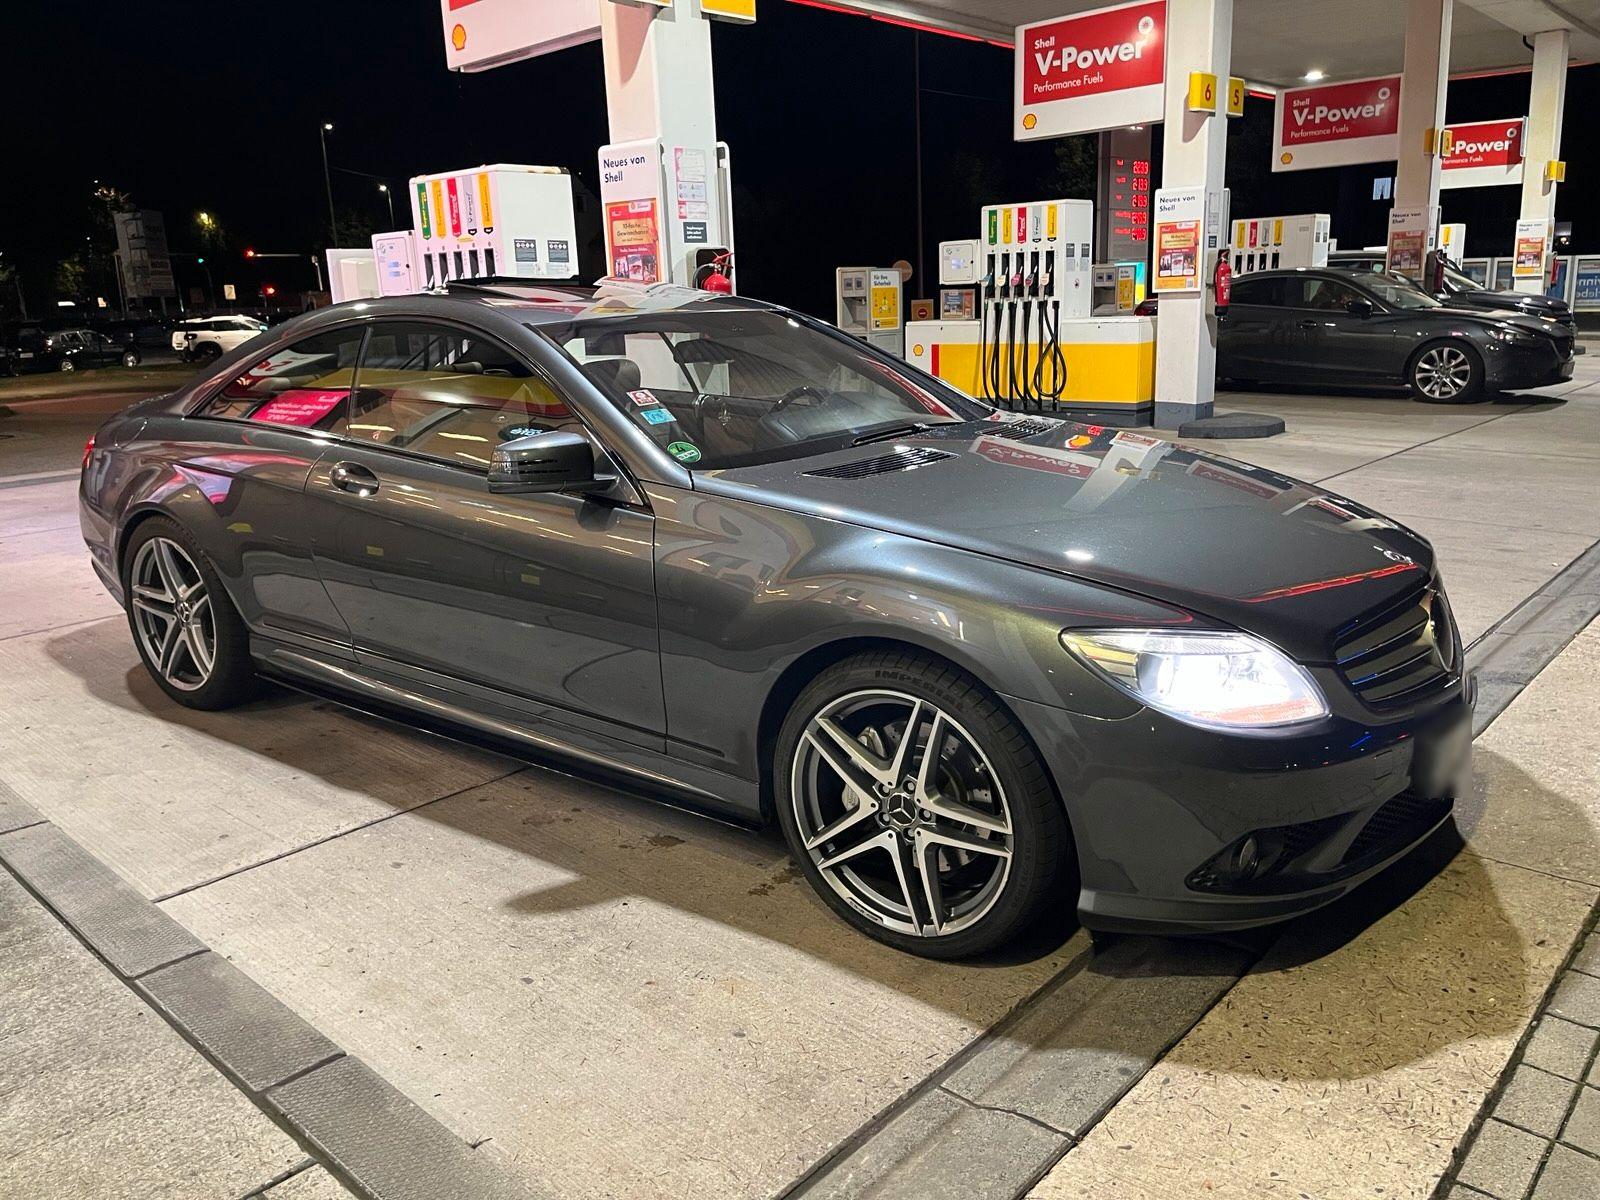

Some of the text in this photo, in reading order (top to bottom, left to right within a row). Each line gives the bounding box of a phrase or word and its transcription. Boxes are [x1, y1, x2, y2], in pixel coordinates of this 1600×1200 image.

[1034, 36, 1056, 49] Shell
[1035, 41, 1147, 76] V-Power
[1033, 72, 1104, 93] Performance Fuels
[1205, 83, 1211, 101] 6
[1233, 89, 1239, 106] 5
[1293, 98, 1310, 107] Shell
[1293, 103, 1385, 127] V-Power
[1290, 124, 1349, 139] Performance Fuels
[1451, 140, 1512, 155] -Power
[603, 156, 645, 169] Neues von
[604, 171, 623, 183] Shell
[1160, 204, 1175, 212] Shell
